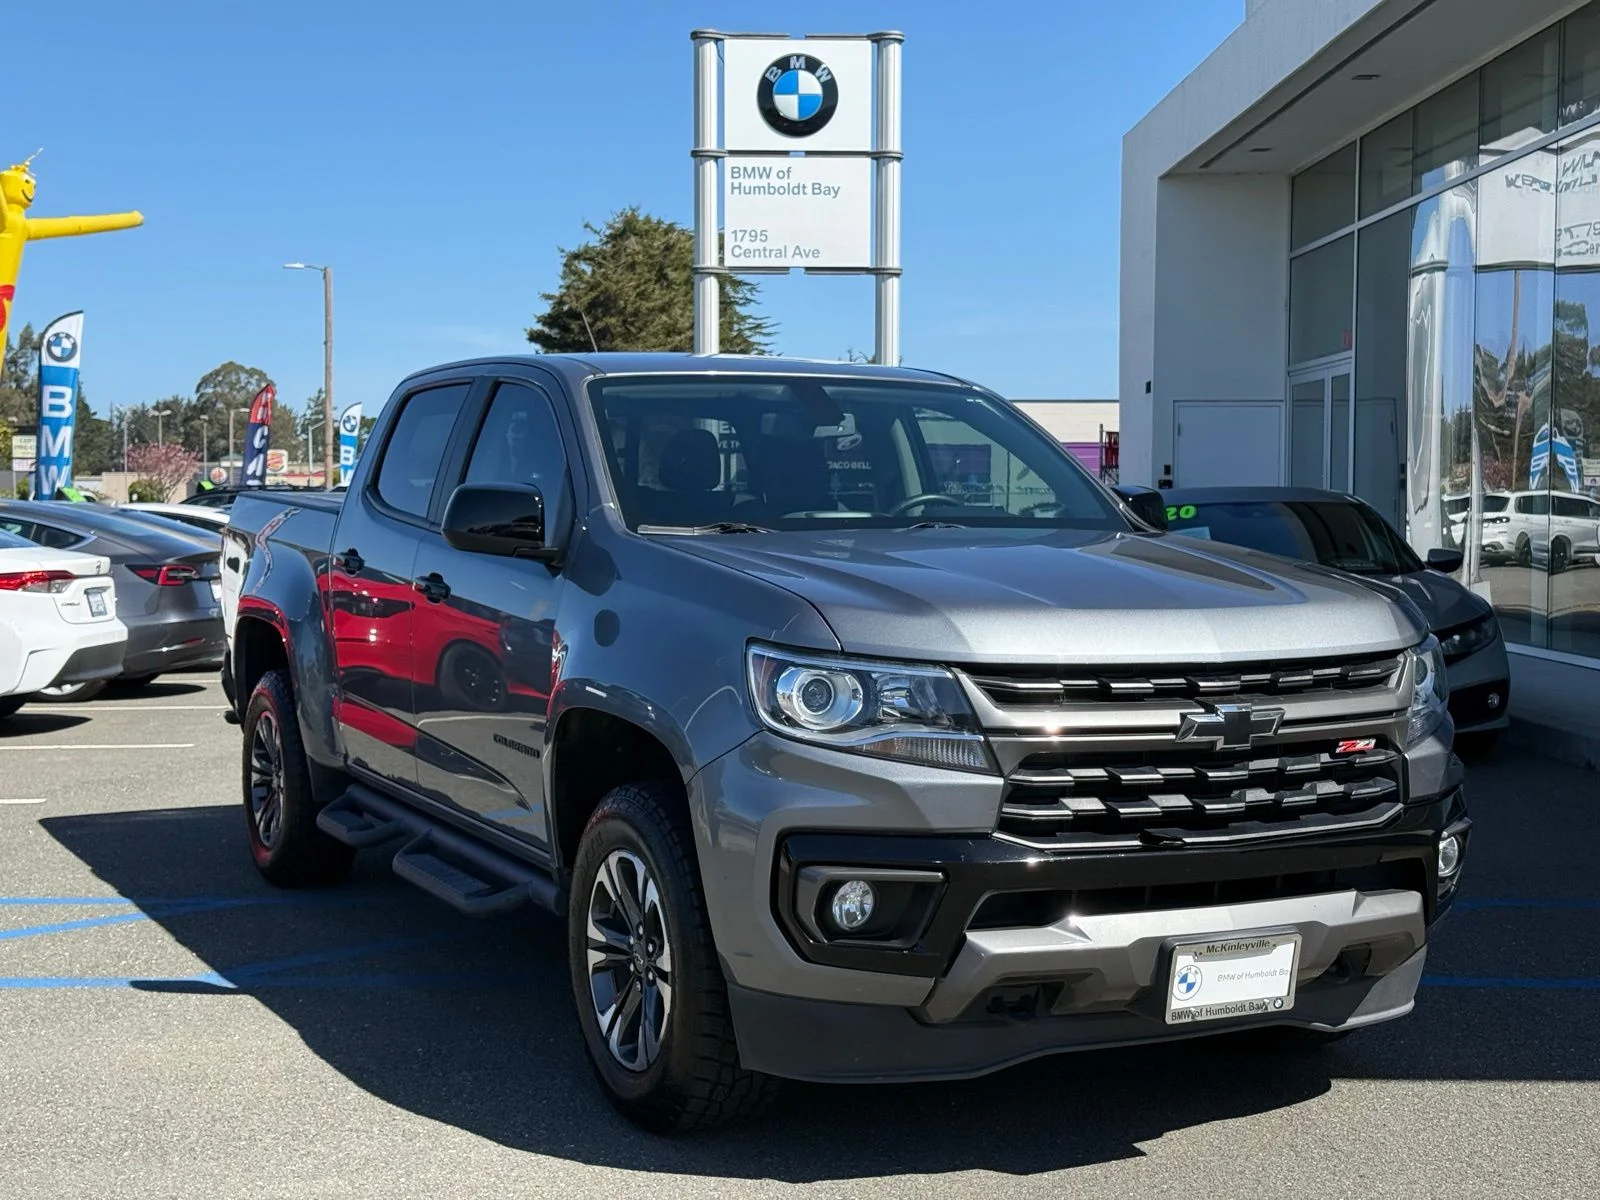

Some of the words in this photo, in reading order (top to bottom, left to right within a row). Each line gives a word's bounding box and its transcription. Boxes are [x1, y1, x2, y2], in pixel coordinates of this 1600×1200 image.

[765, 56, 832, 83] BMW
[730, 166, 772, 180] BMW
[776, 166, 792, 180] of
[730, 182, 808, 196] Humboldt
[811, 183, 841, 199] Bay
[731, 229, 768, 243] 1795
[730, 245, 788, 259] Central
[791, 246, 821, 259] Ave
[40, 385, 73, 495] BMW
[826, 460, 850, 470] TACO
[1206, 939, 1270, 954] McKinleyville
[1217, 974, 1236, 982] BMW
[1237, 972, 1245, 981] of
[1245, 969, 1278, 979] Humboldt
[1171, 1008, 1191, 1021] BMW
[1194, 1005, 1203, 1018] of
[1205, 1002, 1247, 1016] Humboldt
